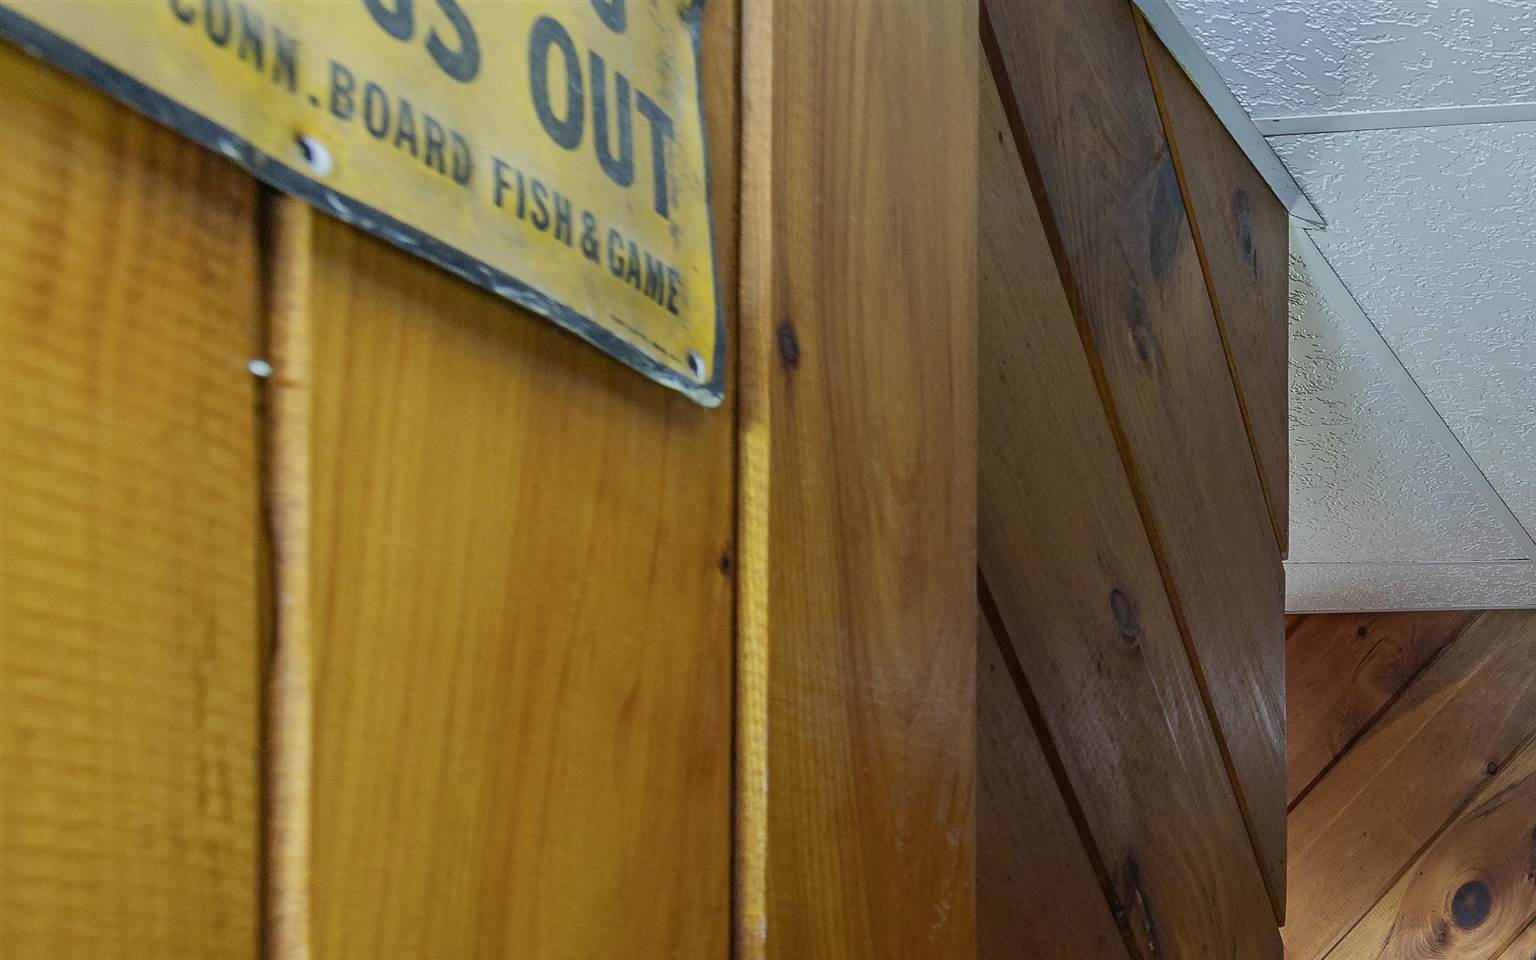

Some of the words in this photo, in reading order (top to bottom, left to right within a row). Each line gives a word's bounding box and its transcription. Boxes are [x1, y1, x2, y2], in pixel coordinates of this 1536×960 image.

[329, 59, 473, 187] BOARD
[363, 0, 481, 83] S
[528, 15, 674, 219] OUT
